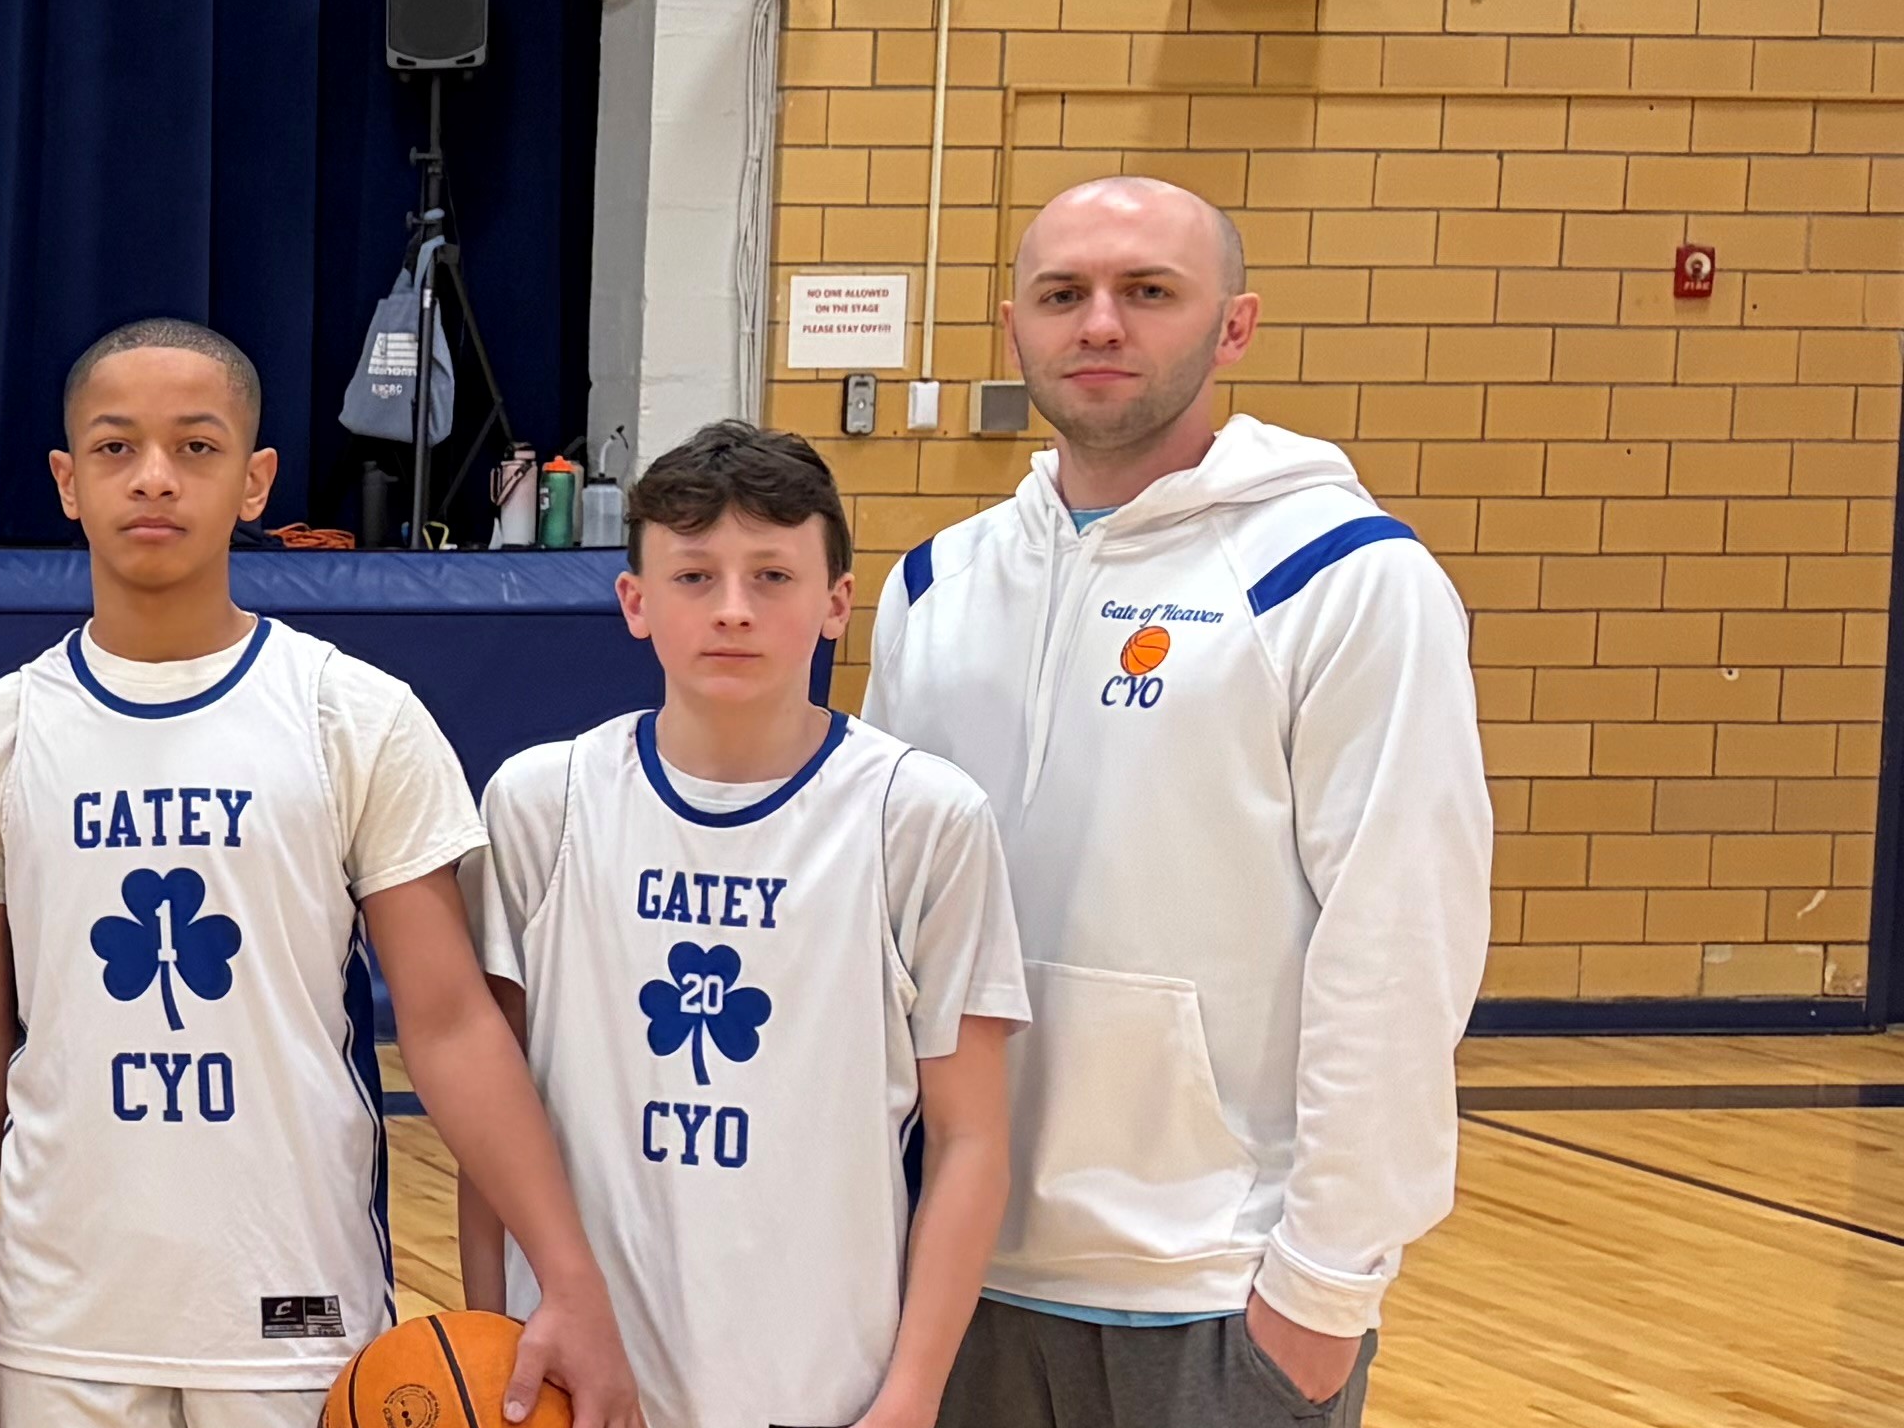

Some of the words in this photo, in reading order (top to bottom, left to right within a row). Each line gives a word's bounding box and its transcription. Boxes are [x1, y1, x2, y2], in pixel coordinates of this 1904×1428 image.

[807, 289, 821, 298] NO
[824, 289, 842, 298] ONE
[845, 289, 889, 298] ALLOWED
[815, 304, 829, 313] ON
[833, 304, 848, 313] THE
[851, 304, 879, 313] STAGE
[802, 325, 833, 333] PLEASE
[837, 325, 858, 333] STAY
[1100, 600, 1137, 621] Gate
[1139, 604, 1163, 628] of
[1161, 604, 1224, 623] Heaven
[1100, 675, 1164, 709] CYO
[73, 787, 252, 849] GATEY
[637, 869, 787, 930] GATEY
[154, 899, 177, 962] 1
[680, 972, 724, 1015] 20
[111, 1052, 235, 1123] CYO
[642, 1100, 750, 1168] CYO
